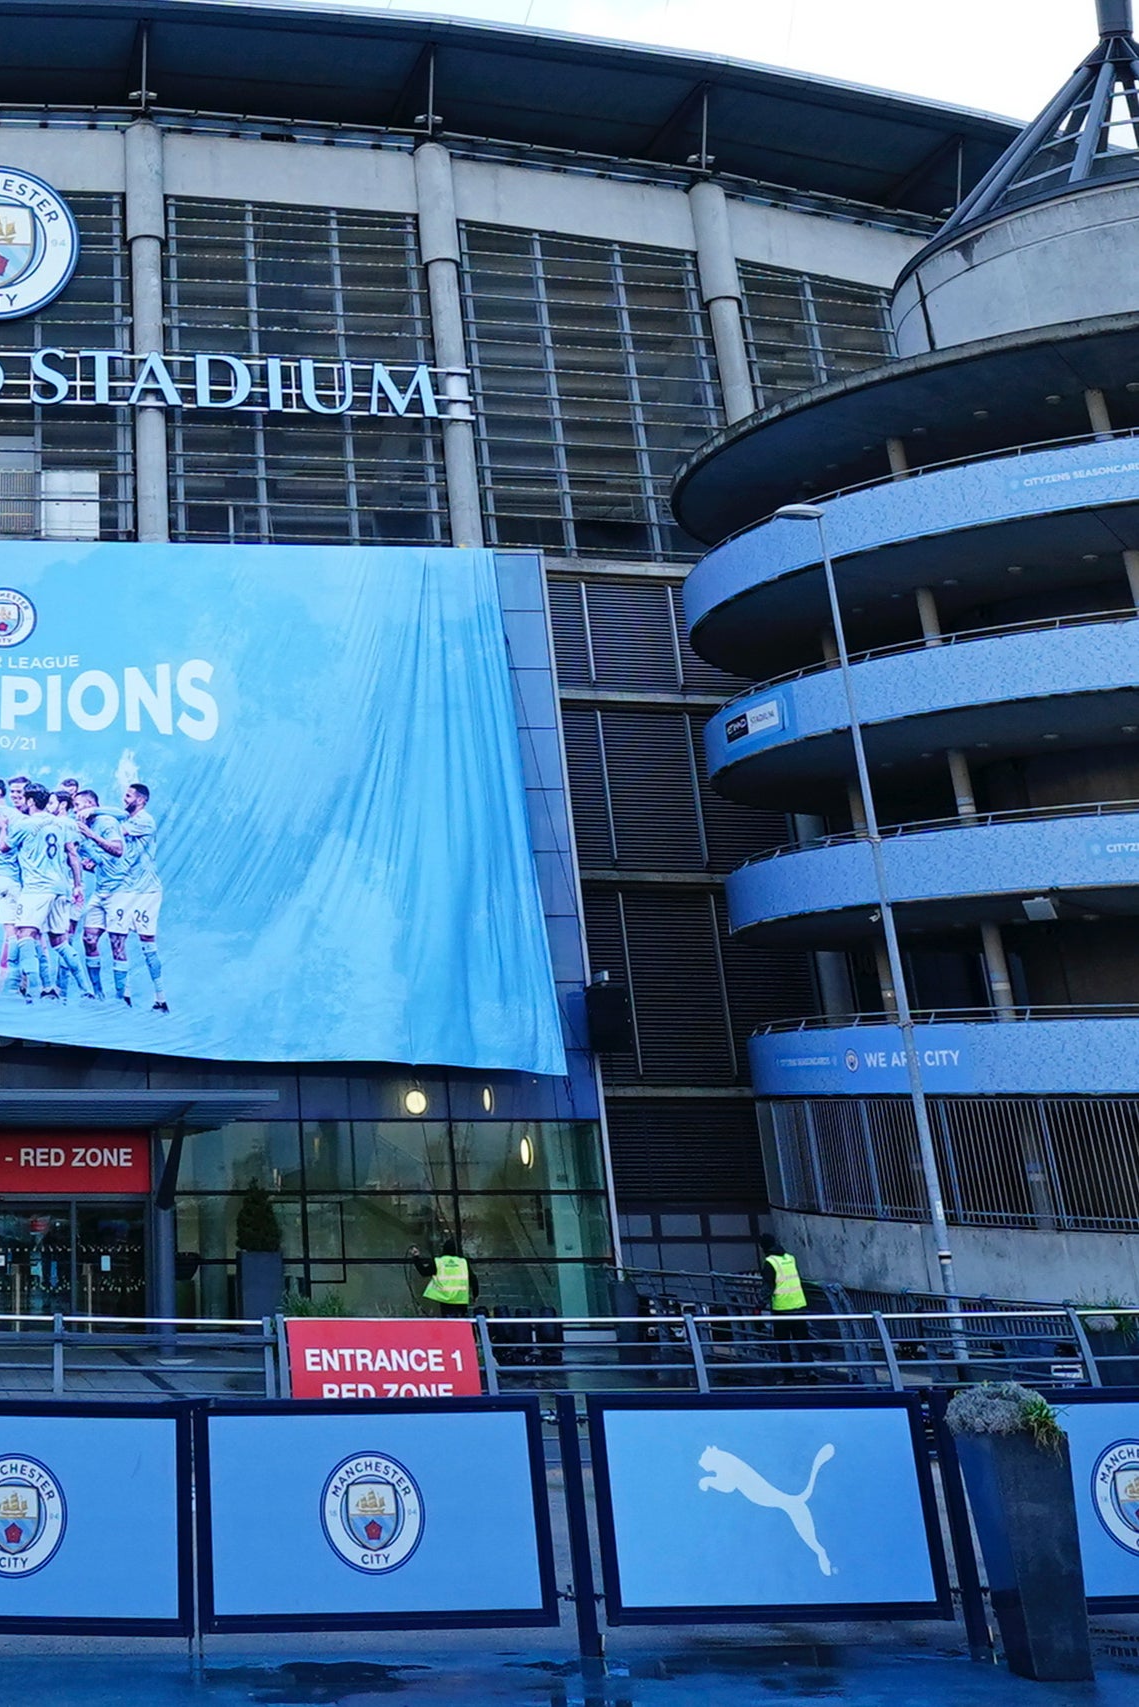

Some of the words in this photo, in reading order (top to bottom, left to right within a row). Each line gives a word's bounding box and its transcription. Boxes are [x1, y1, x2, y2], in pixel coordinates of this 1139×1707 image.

[31, 347, 439, 417] STADIUM
[1023, 472, 1071, 487] CITYZENS
[8, 655, 79, 669] LEAGUE
[45, 832, 58, 860] 8
[116, 908, 124, 921] 9
[134, 909, 150, 923] 26
[864, 1052, 888, 1068] WE
[891, 1050, 921, 1068] AR
[923, 1050, 961, 1067] CITY
[20, 1147, 65, 1167] RED
[71, 1148, 133, 1168] ZONE
[304, 1348, 445, 1372] ENTRANCE
[451, 1350, 463, 1372] 1
[331, 1461, 412, 1498] MANCHESTER
[360, 1554, 390, 1565] CITY
